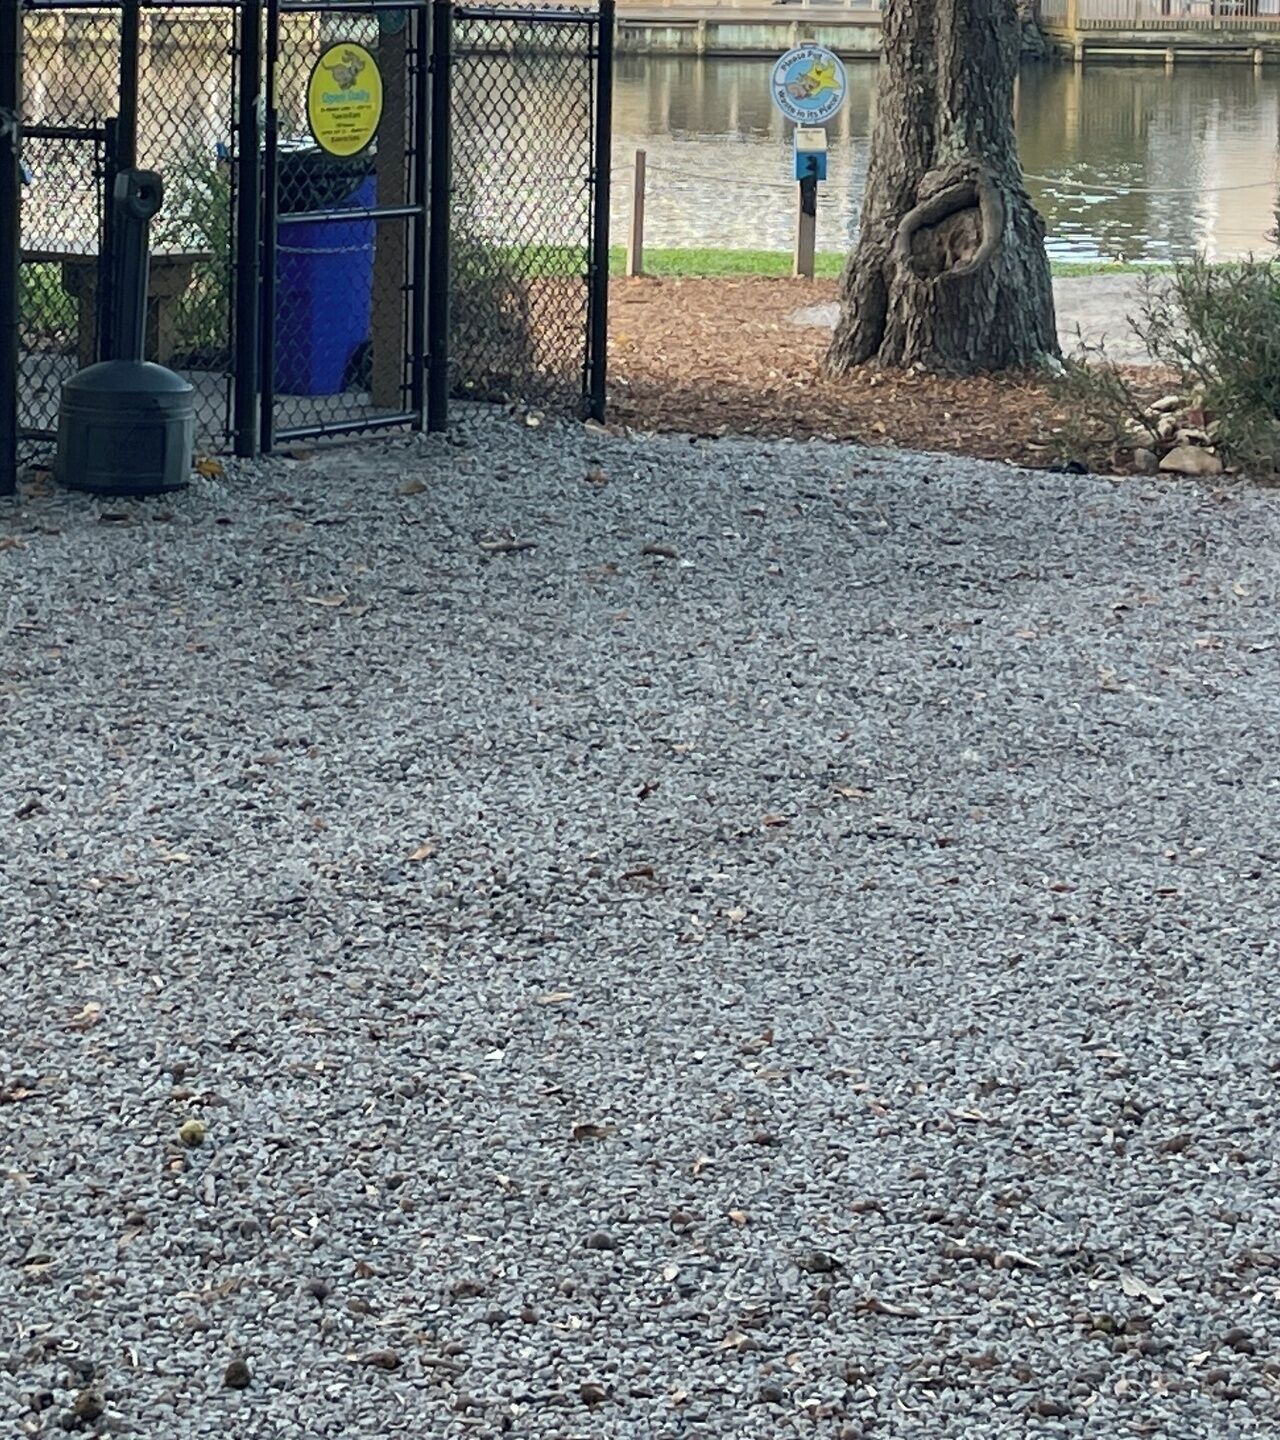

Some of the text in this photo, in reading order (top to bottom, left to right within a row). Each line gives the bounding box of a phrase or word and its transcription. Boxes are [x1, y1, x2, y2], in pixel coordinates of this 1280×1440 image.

[780, 52, 806, 71] Please
[778, 89, 796, 114] Waste
[796, 110, 806, 118] in
